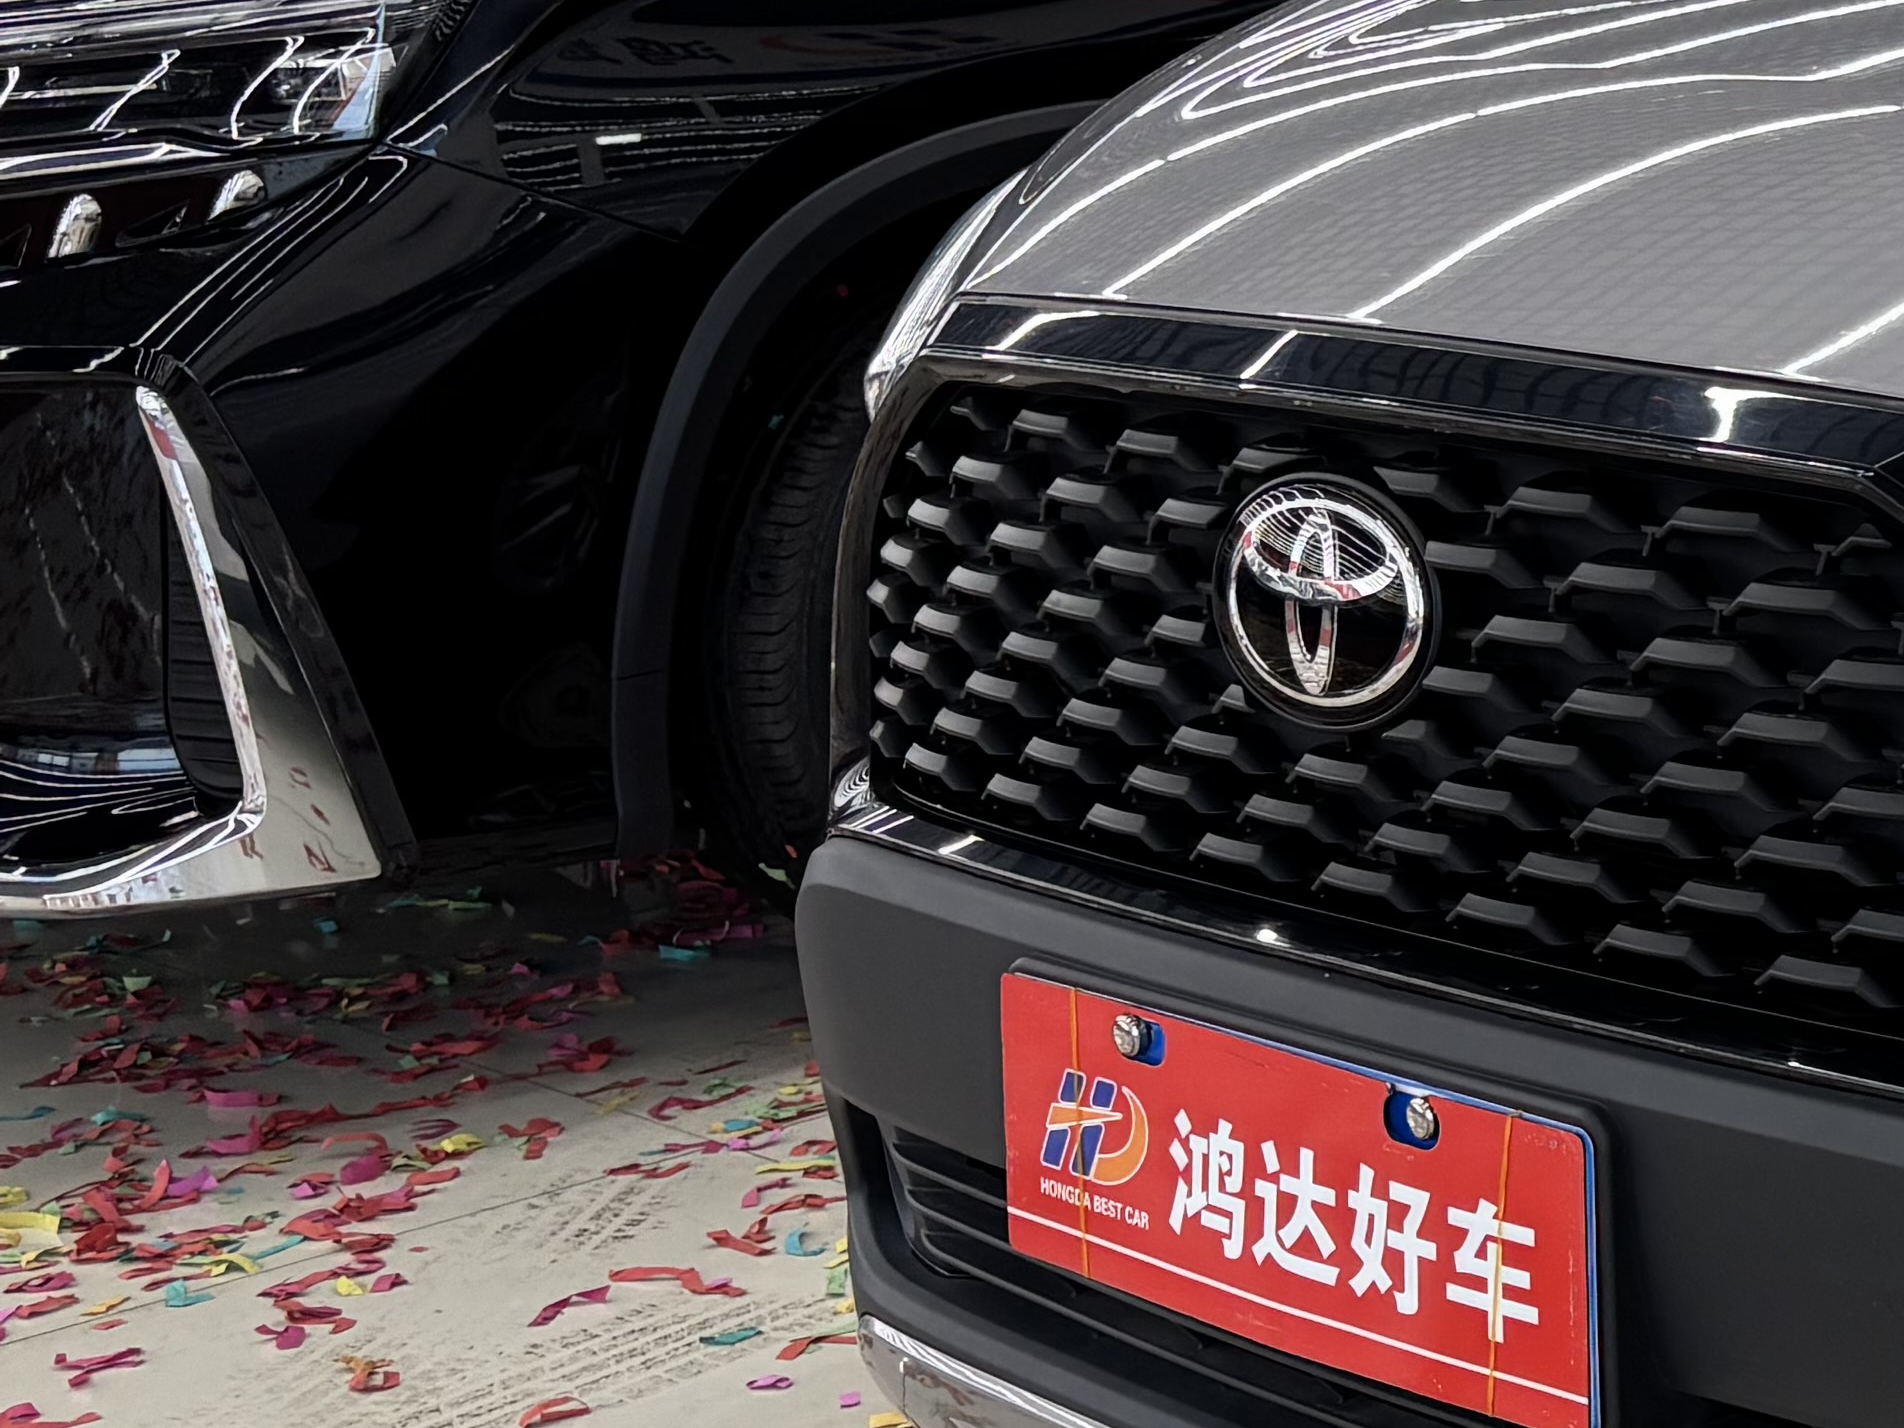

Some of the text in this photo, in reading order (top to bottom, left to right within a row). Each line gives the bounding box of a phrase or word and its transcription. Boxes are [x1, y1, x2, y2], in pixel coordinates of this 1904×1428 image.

[1040, 1177, 1150, 1230] HONGDA BEST CAR
[1167, 1108, 1539, 1343] 鸿达好车
